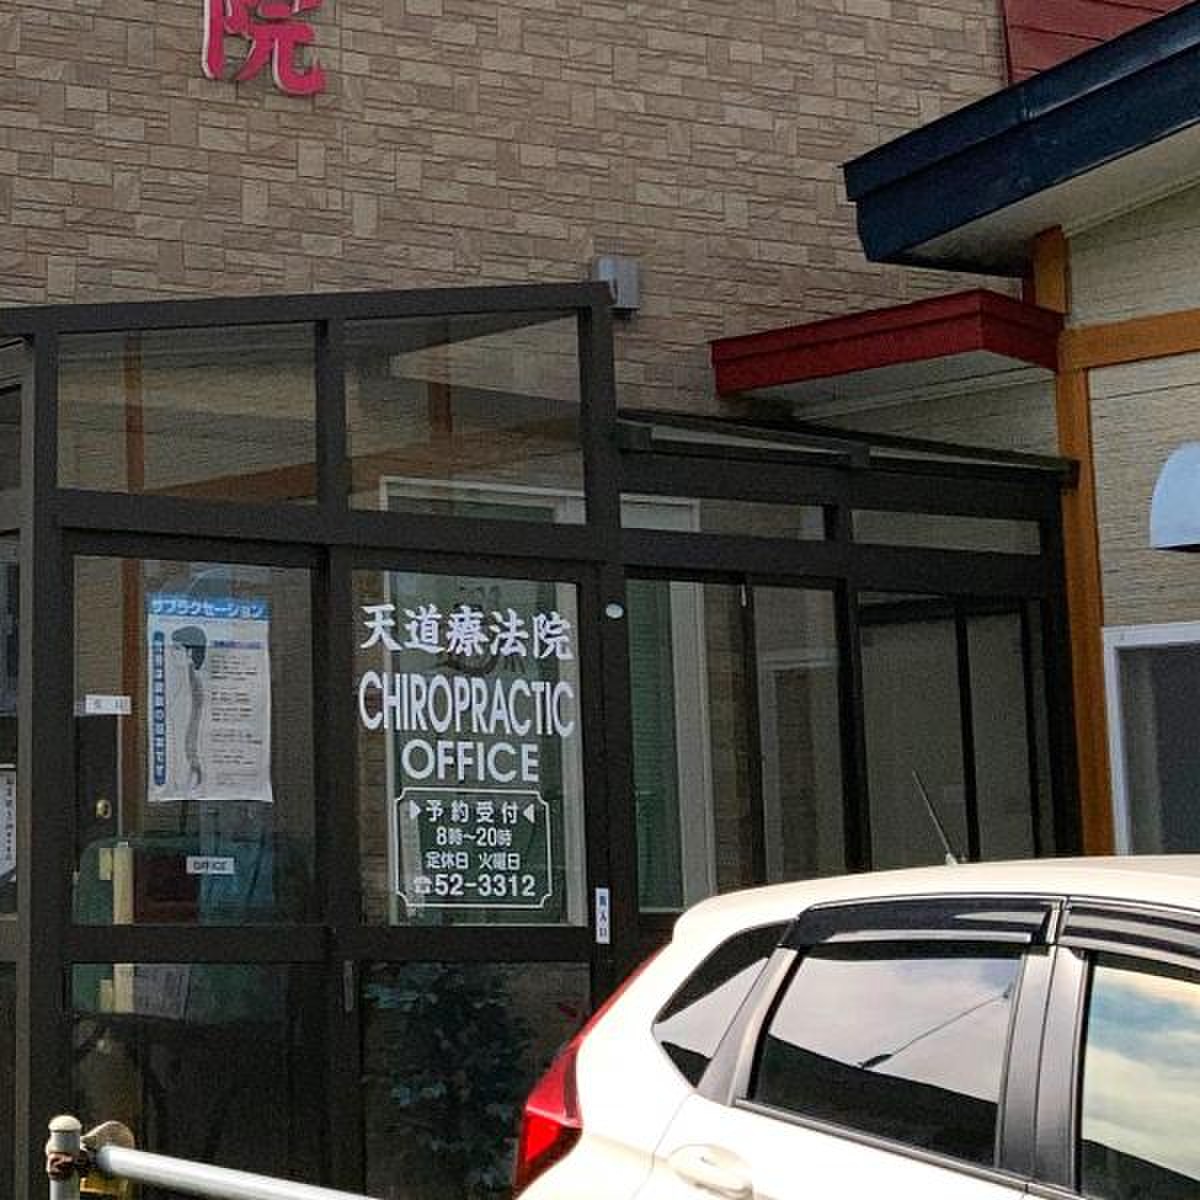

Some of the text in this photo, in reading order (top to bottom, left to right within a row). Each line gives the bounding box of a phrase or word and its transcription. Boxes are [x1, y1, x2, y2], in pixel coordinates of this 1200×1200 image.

[360, 602, 574, 660] 天道療法院
[358, 670, 575, 738] CHIROPRACTIC
[401, 738, 540, 783] OFFICE
[425, 799, 520, 824] 予約受付
[425, 851, 521, 871] 定休日 火曜日
